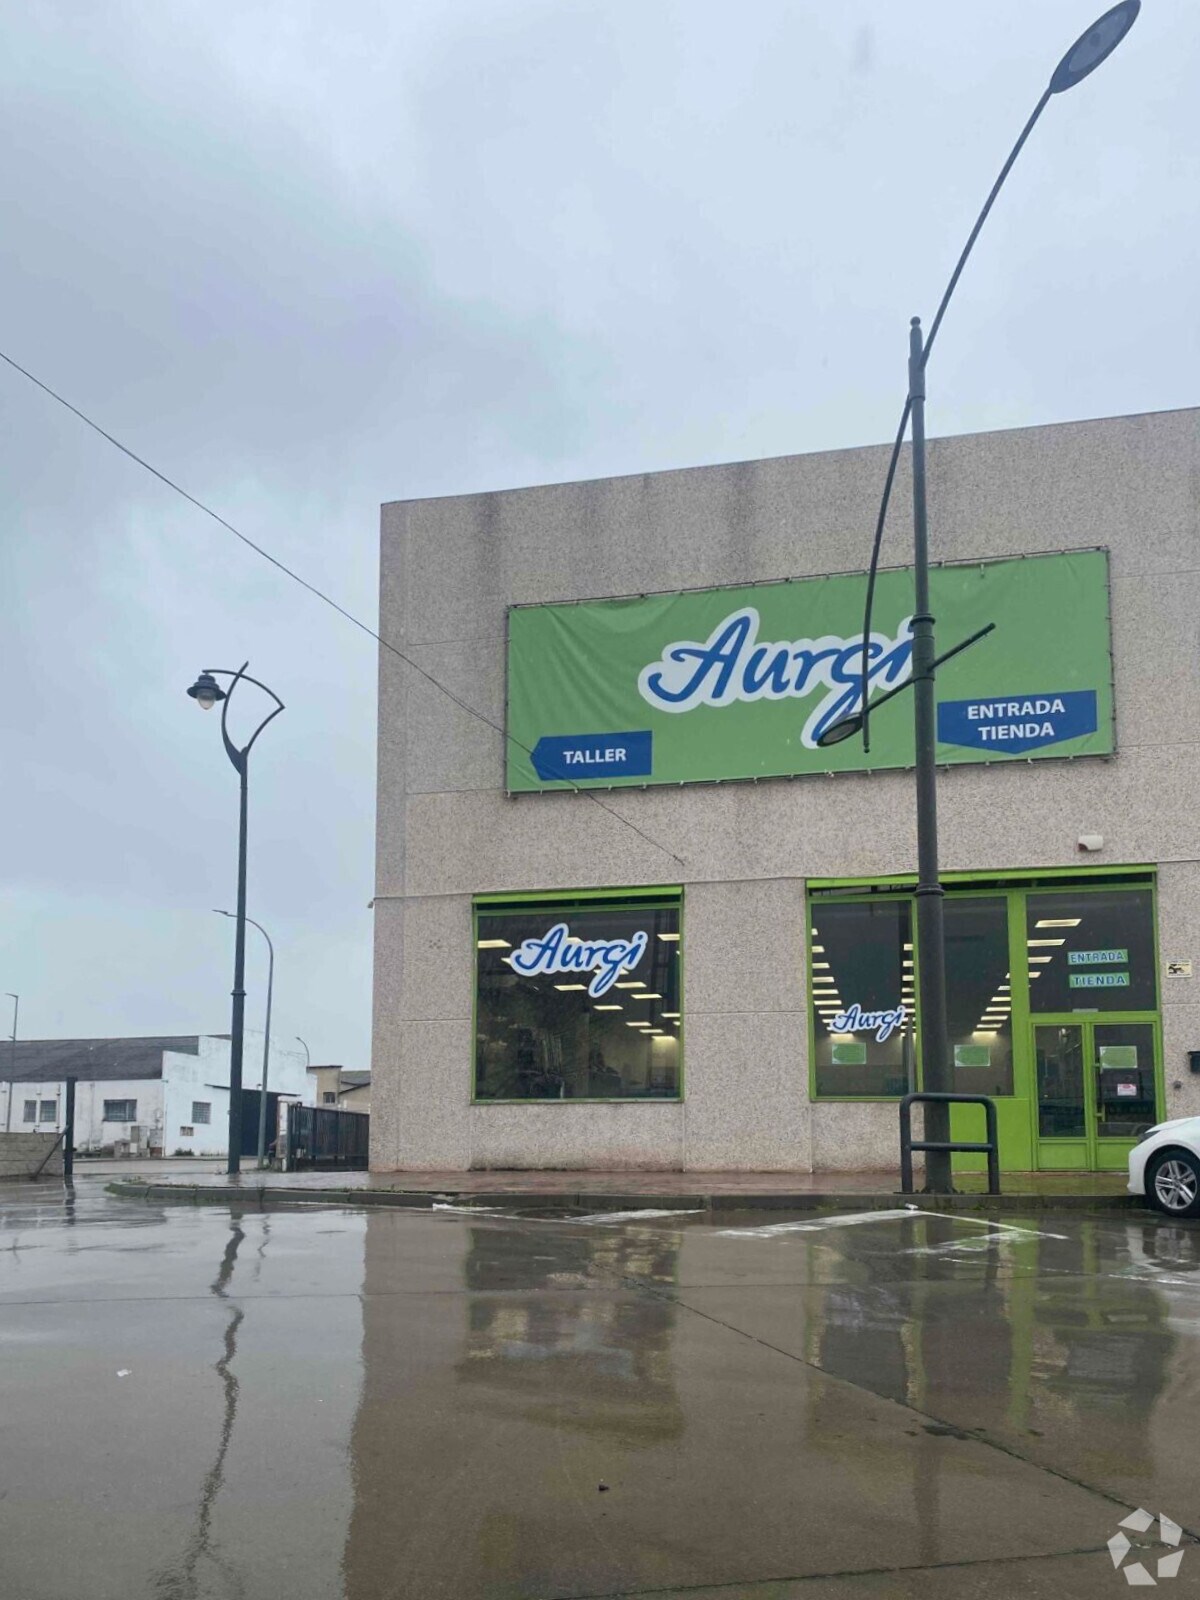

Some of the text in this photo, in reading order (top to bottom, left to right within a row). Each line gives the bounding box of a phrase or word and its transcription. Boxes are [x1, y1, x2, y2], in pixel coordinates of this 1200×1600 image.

[644, 612, 914, 745] Aurgi
[967, 699, 1066, 720] ENTRADA
[977, 721, 1056, 741] TIENDA
[562, 748, 627, 764] TALLER
[512, 925, 646, 995] Aurgi
[1070, 951, 1125, 963] ENTRADA
[1074, 975, 1125, 986] TIENDA
[832, 1004, 905, 1041] Aurgi
